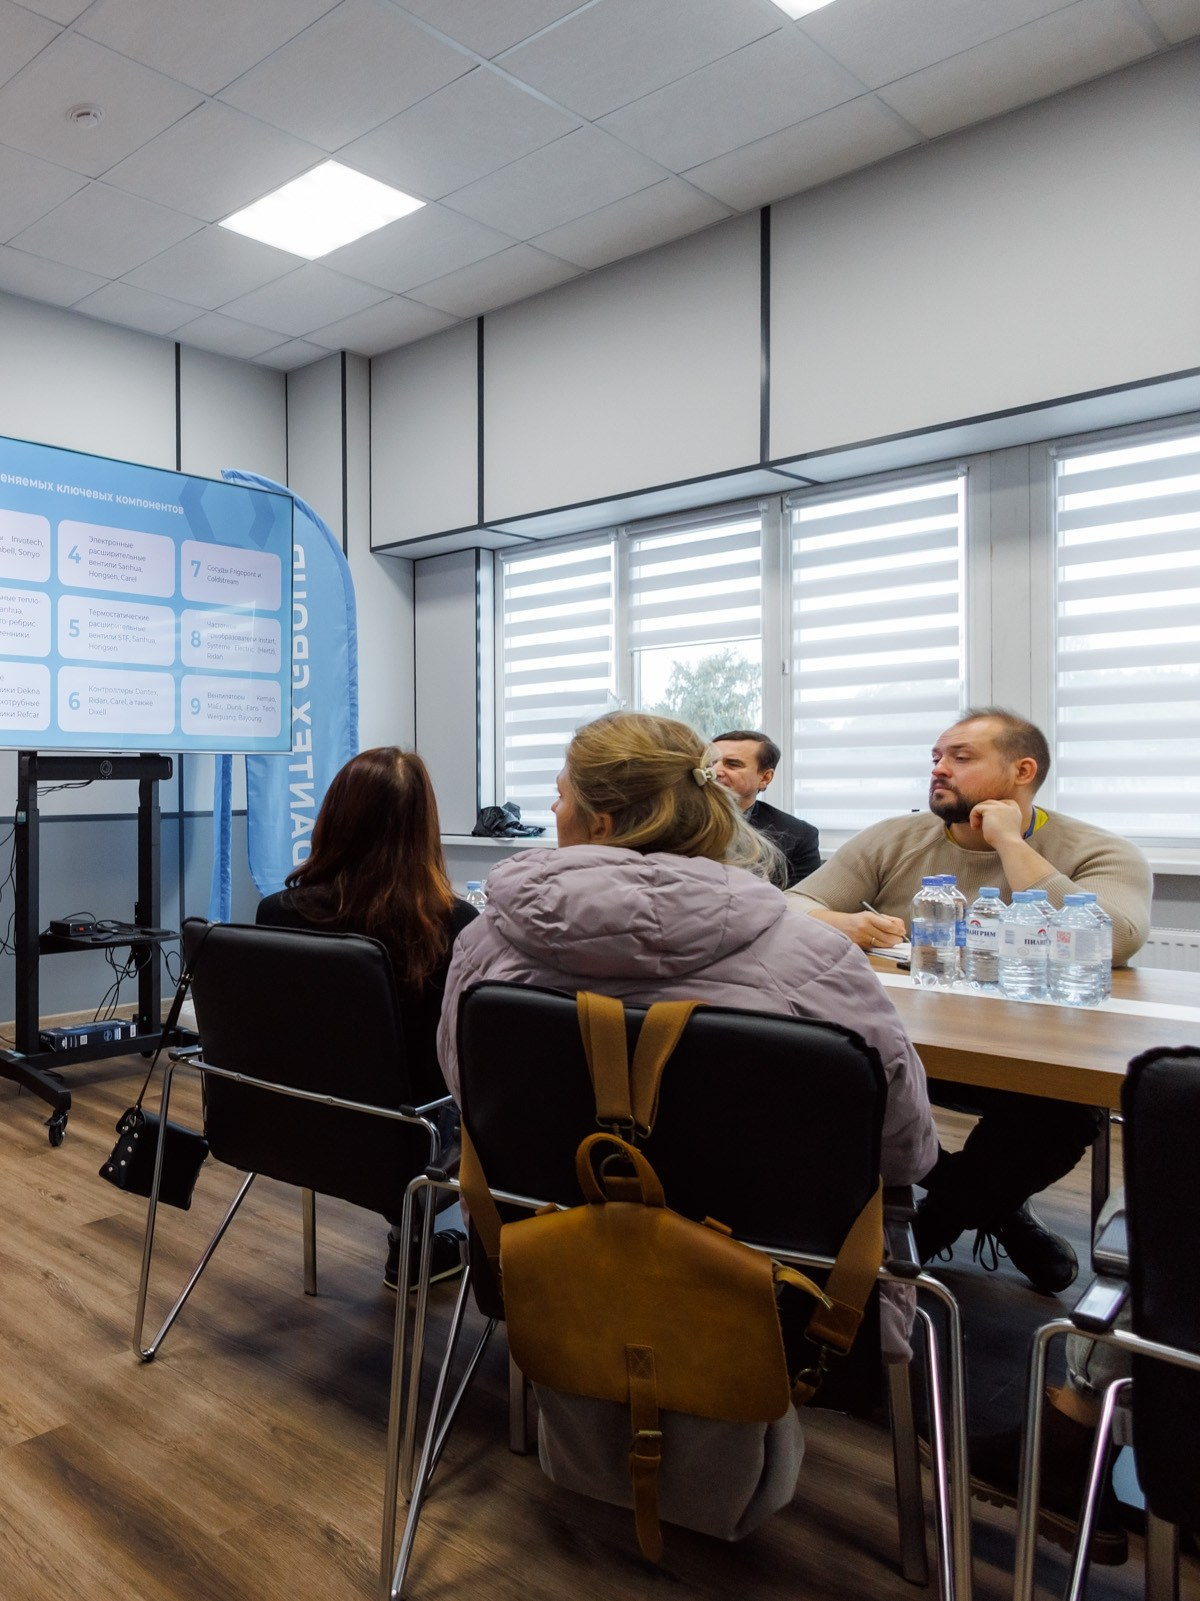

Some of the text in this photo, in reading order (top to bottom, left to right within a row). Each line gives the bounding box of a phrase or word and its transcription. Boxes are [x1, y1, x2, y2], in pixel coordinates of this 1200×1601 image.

[56, 483, 113, 502] ключевых
[115, 494, 184, 515] компонентов
[11, 535, 44, 548] Invotech,
[88, 535, 134, 549] Электронные
[67, 544, 81, 565] 4
[88, 548, 147, 562] расширительные
[88, 560, 117, 569] вентили
[191, 560, 201, 578] 7
[120, 573, 138, 583] Carel
[88, 608, 150, 622] Термостатические
[69, 618, 80, 638] 5
[88, 633, 117, 641] вентили
[191, 630, 201, 648] 8
[68, 691, 81, 711] 6
[191, 697, 201, 715] 9
